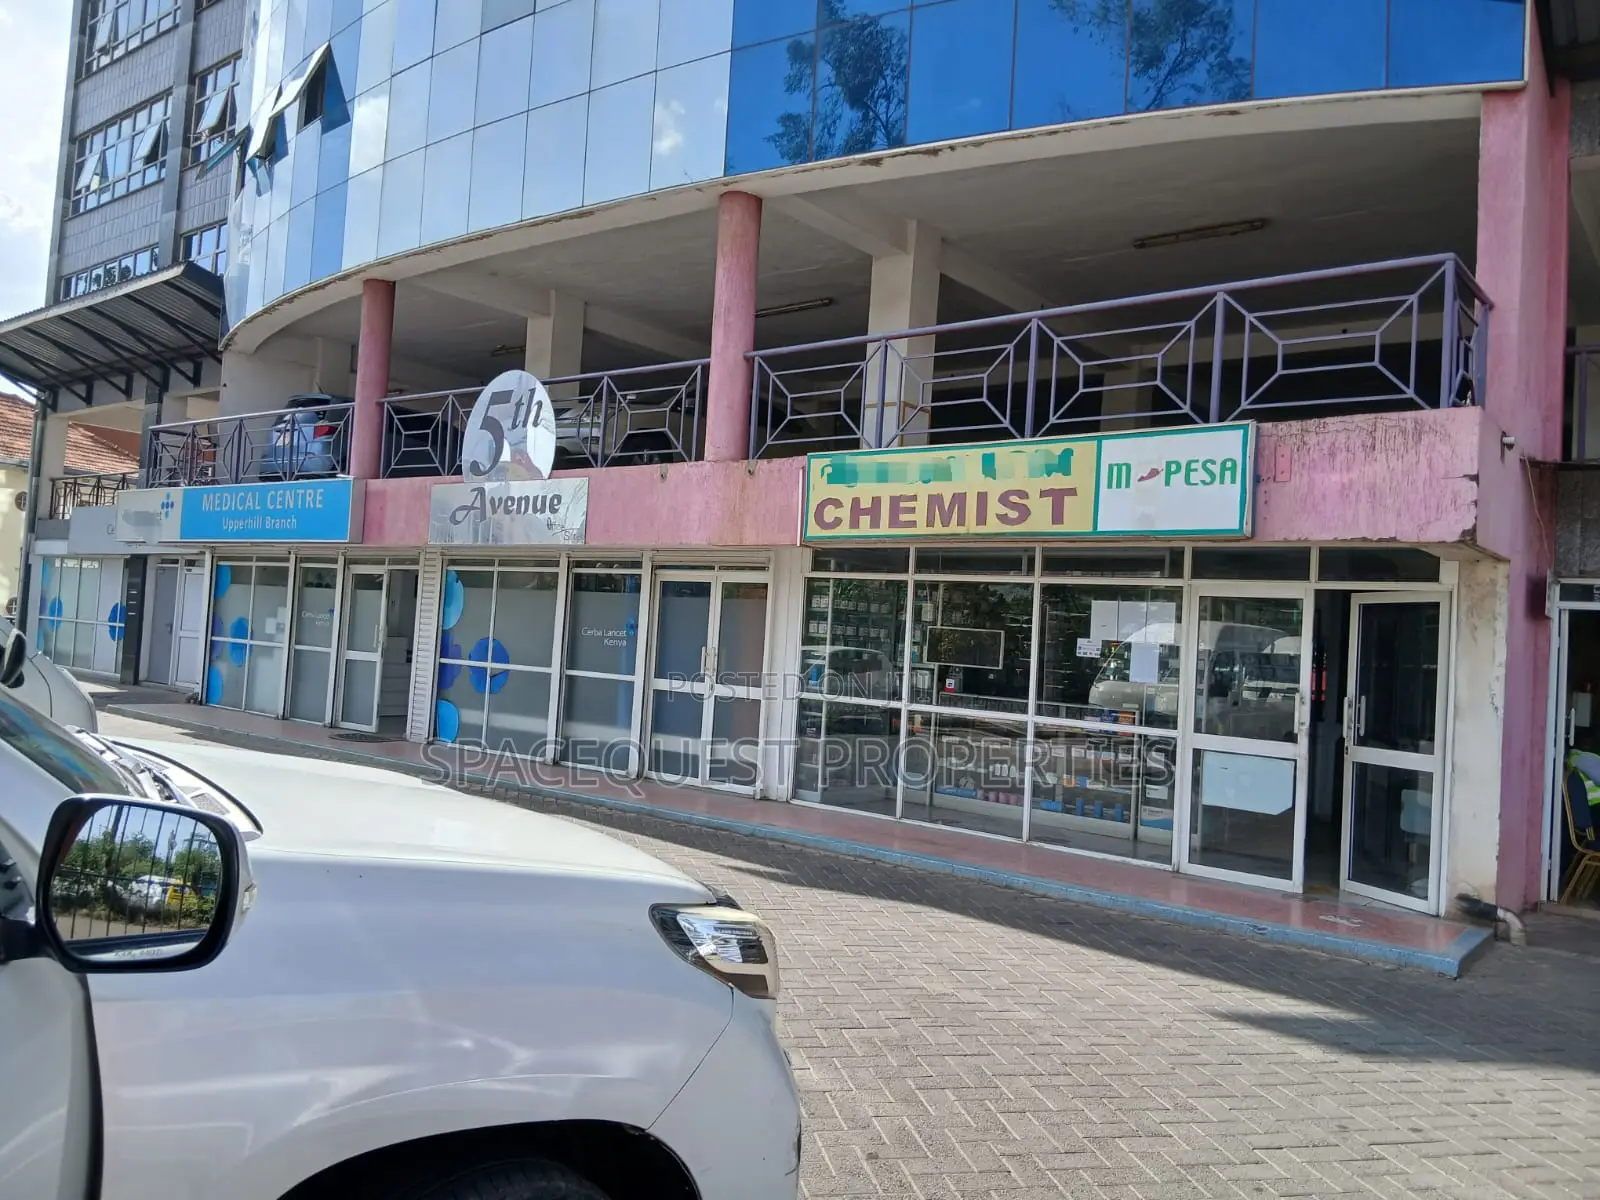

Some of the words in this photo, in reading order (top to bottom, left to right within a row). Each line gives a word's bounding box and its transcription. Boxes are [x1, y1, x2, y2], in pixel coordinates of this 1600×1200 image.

[469, 387, 544, 477] 5th
[1164, 457, 1238, 487] PESA
[202, 491, 262, 512] MEDICAL
[267, 488, 325, 510] CENTRE
[450, 486, 563, 526] Avenue
[813, 487, 1078, 531] CHEMIST
[223, 515, 263, 533] Upperhill
[265, 514, 297, 530] Branch
[603, 638, 627, 648] Kenya
